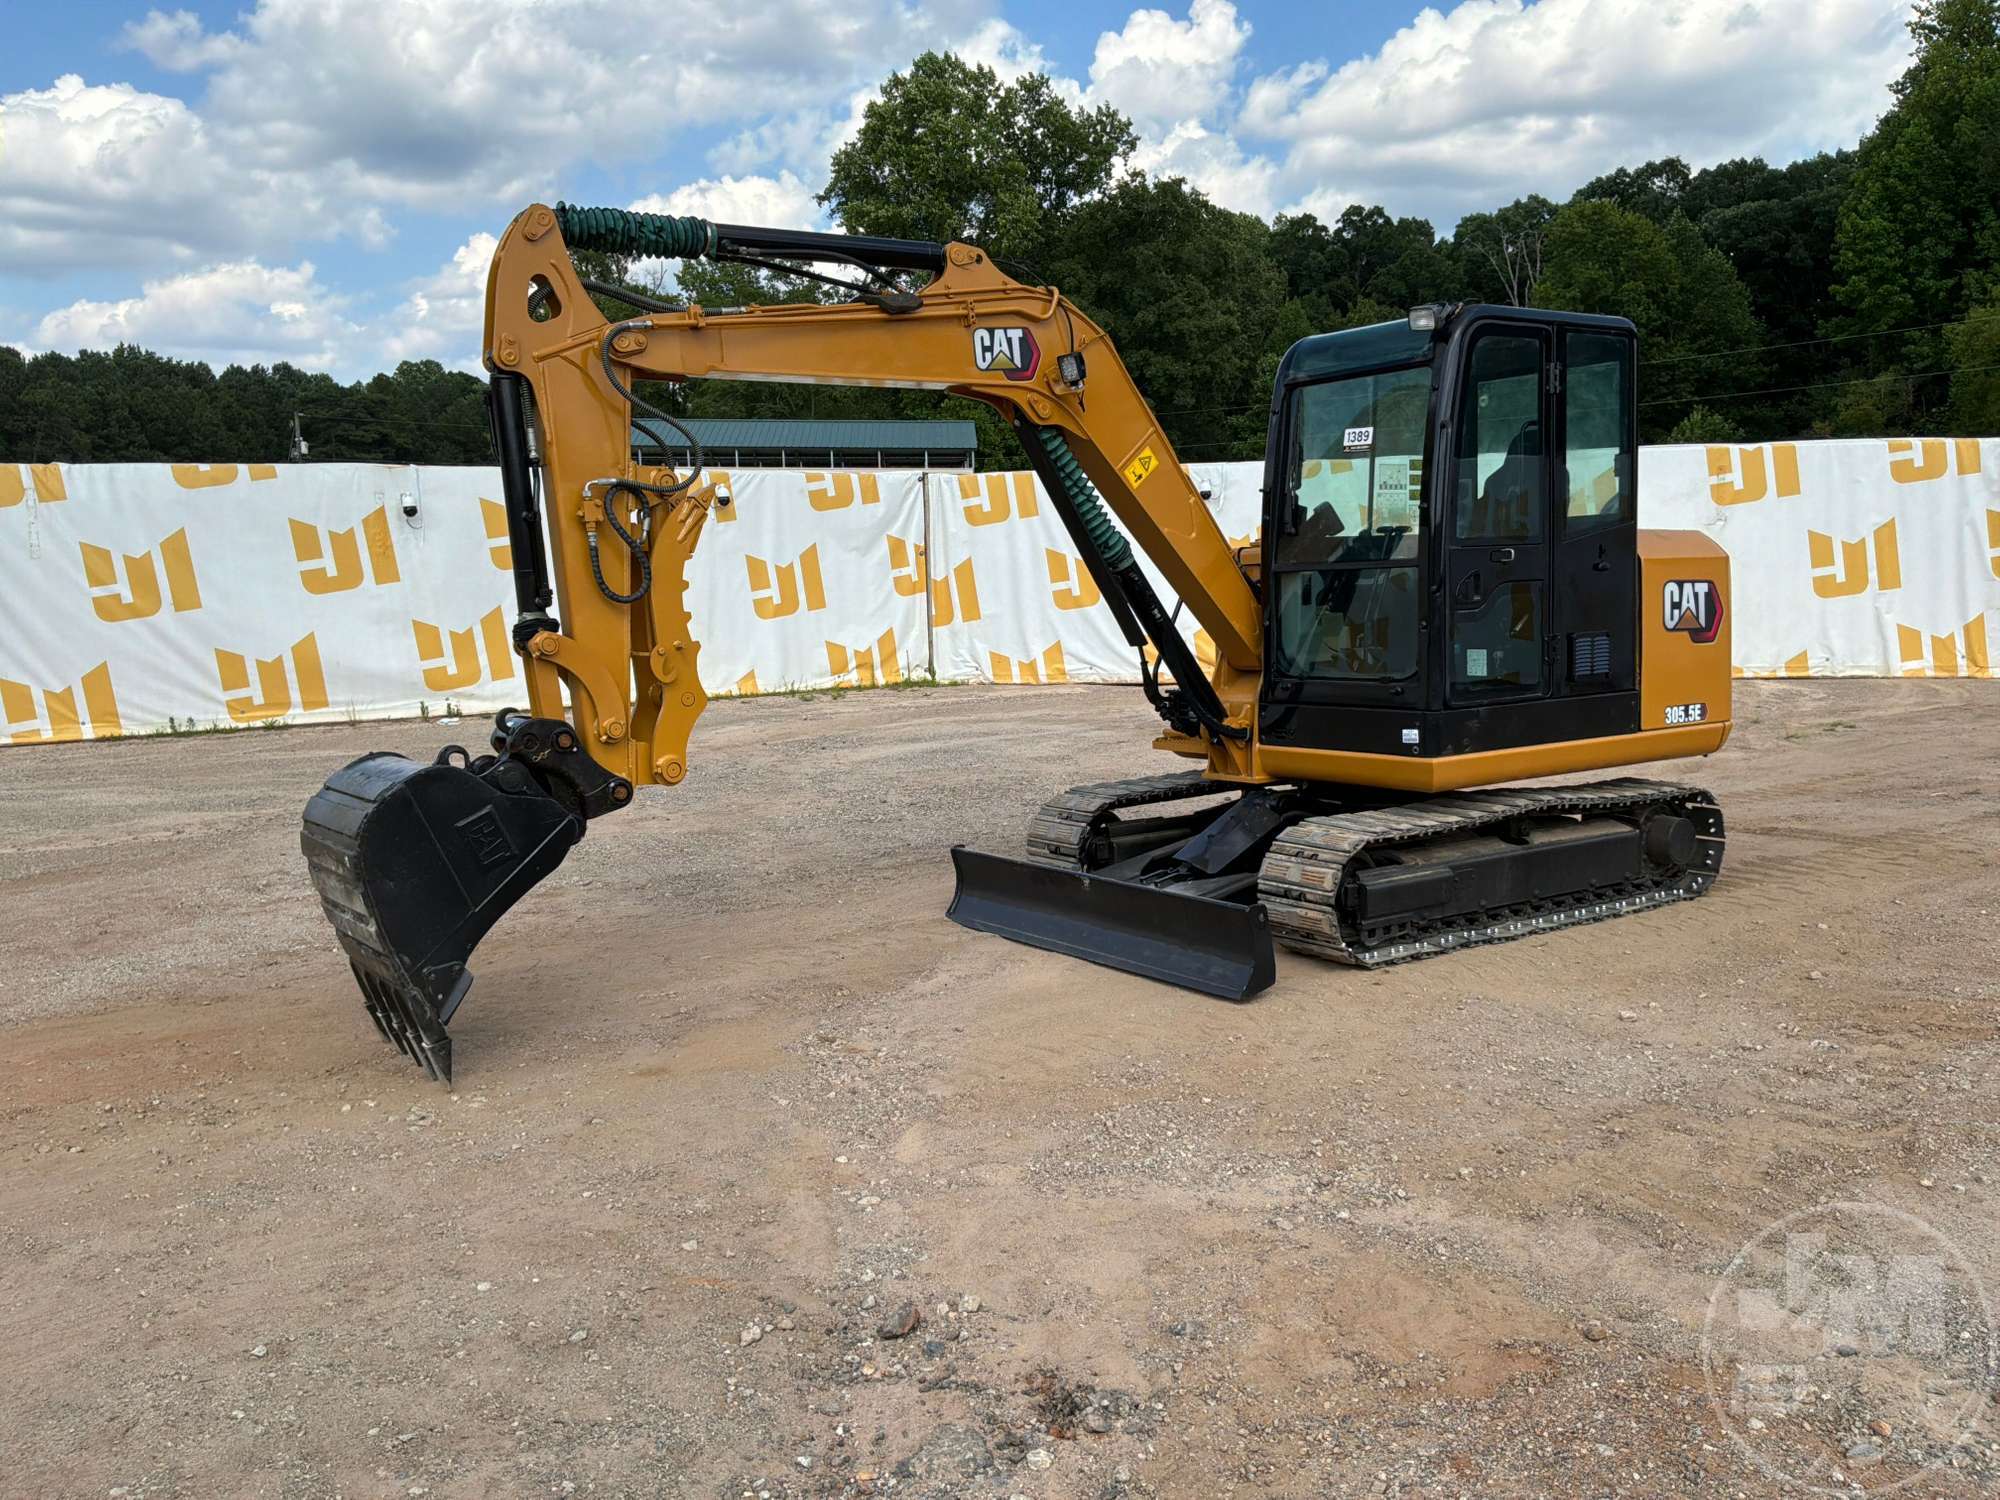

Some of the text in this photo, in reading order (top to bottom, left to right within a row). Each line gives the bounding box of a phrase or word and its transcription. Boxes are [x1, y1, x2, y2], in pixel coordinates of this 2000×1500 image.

[974, 328, 1024, 370] CAT
[1347, 430, 1370, 443] 1389
[1664, 581, 1708, 629] CAT
[1665, 703, 1701, 724] 305.5E
